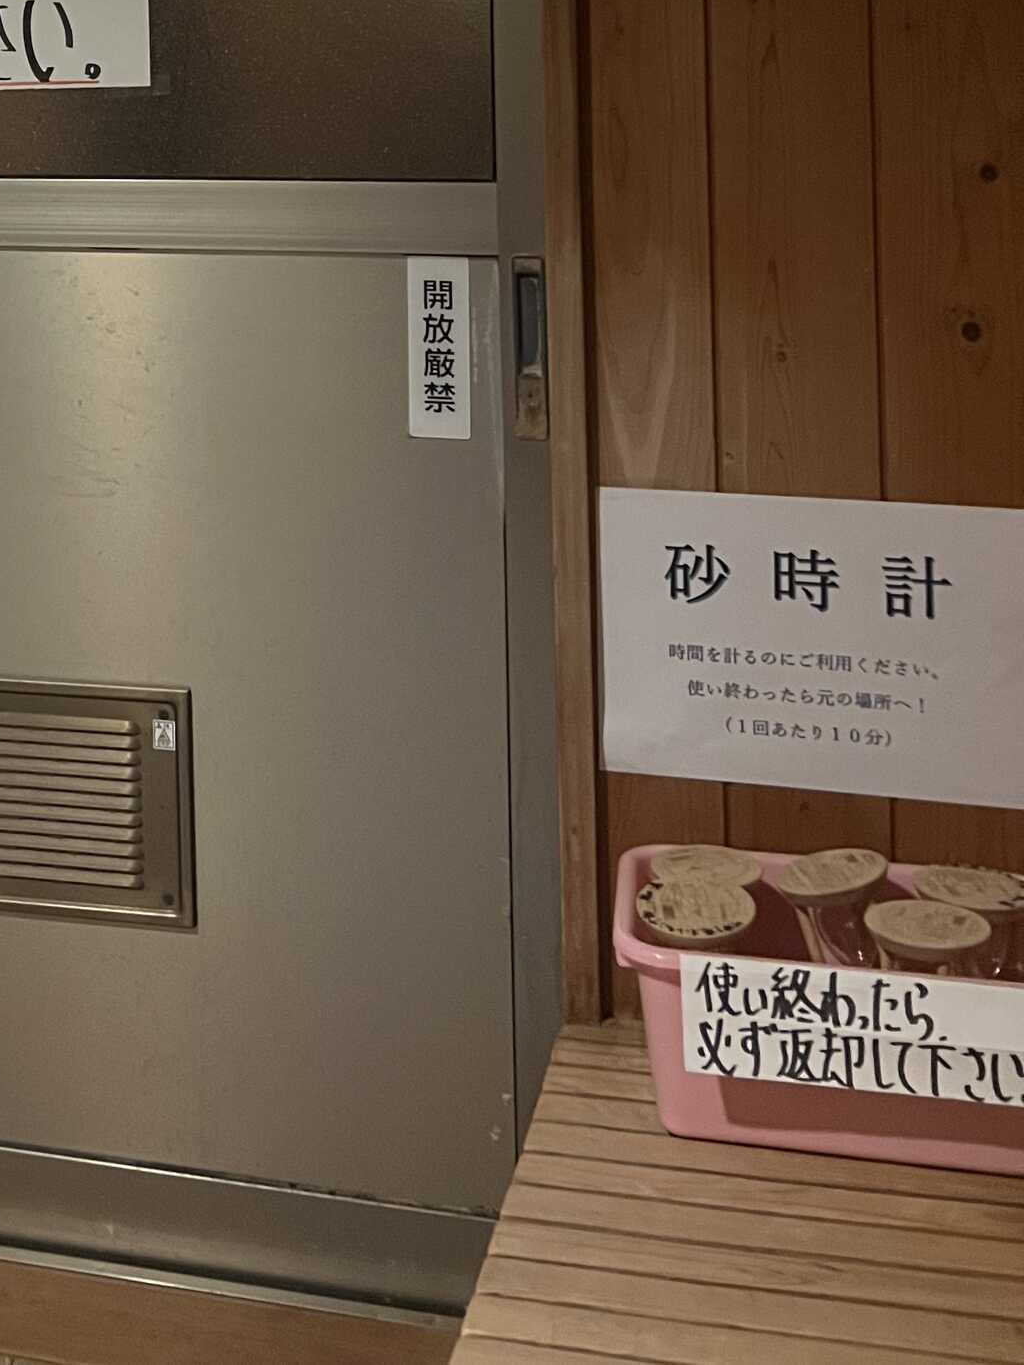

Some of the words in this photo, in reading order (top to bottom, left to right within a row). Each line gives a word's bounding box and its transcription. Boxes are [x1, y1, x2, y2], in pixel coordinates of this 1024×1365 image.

[422, 279, 456, 414] 開放厳禁
[664, 543, 953, 620] 砂時計
[669, 643, 938, 680] 時間を計るのにご利用ください。
